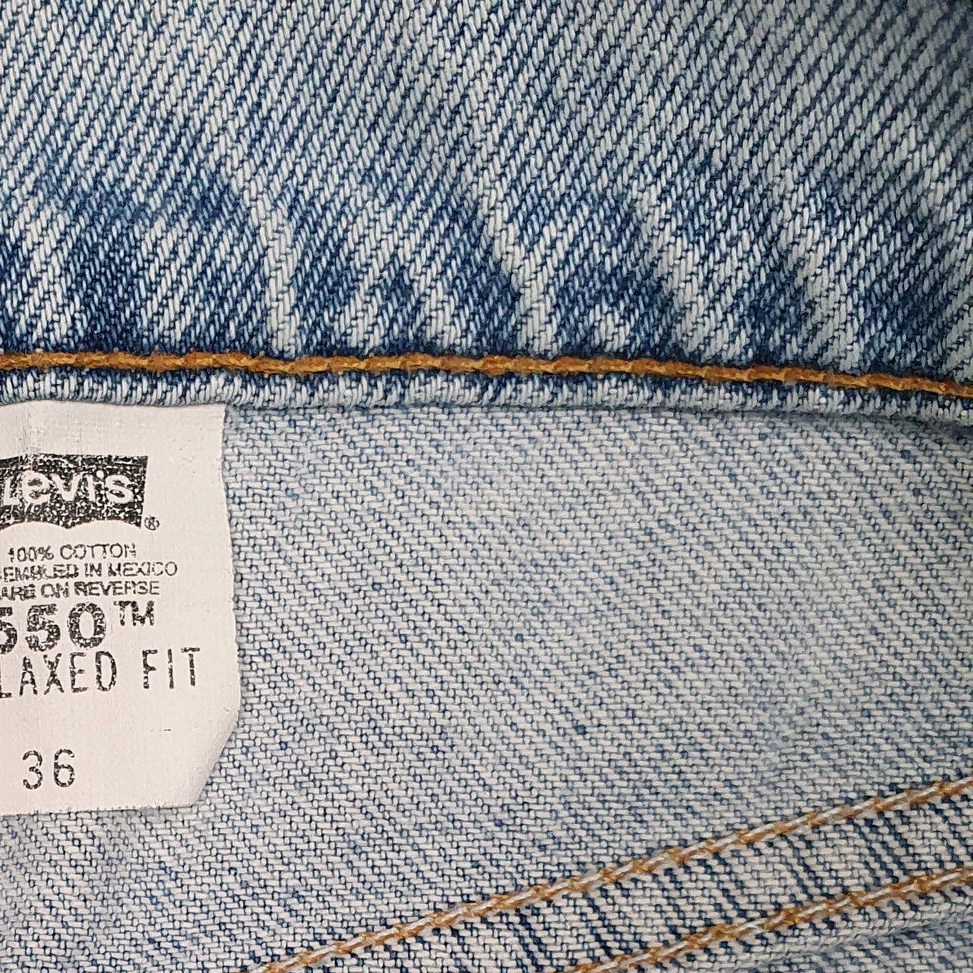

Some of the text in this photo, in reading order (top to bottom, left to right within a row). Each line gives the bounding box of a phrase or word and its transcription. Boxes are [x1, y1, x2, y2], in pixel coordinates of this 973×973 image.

[6, 542, 137, 563] 100% COTTON
[84, 563, 103, 577] IN
[107, 561, 178, 578] MEXICO
[40, 583, 70, 599] ON
[73, 580, 160, 597] REVERSE
[142, 646, 201, 690] FIT
[22, 748, 76, 790] 36
